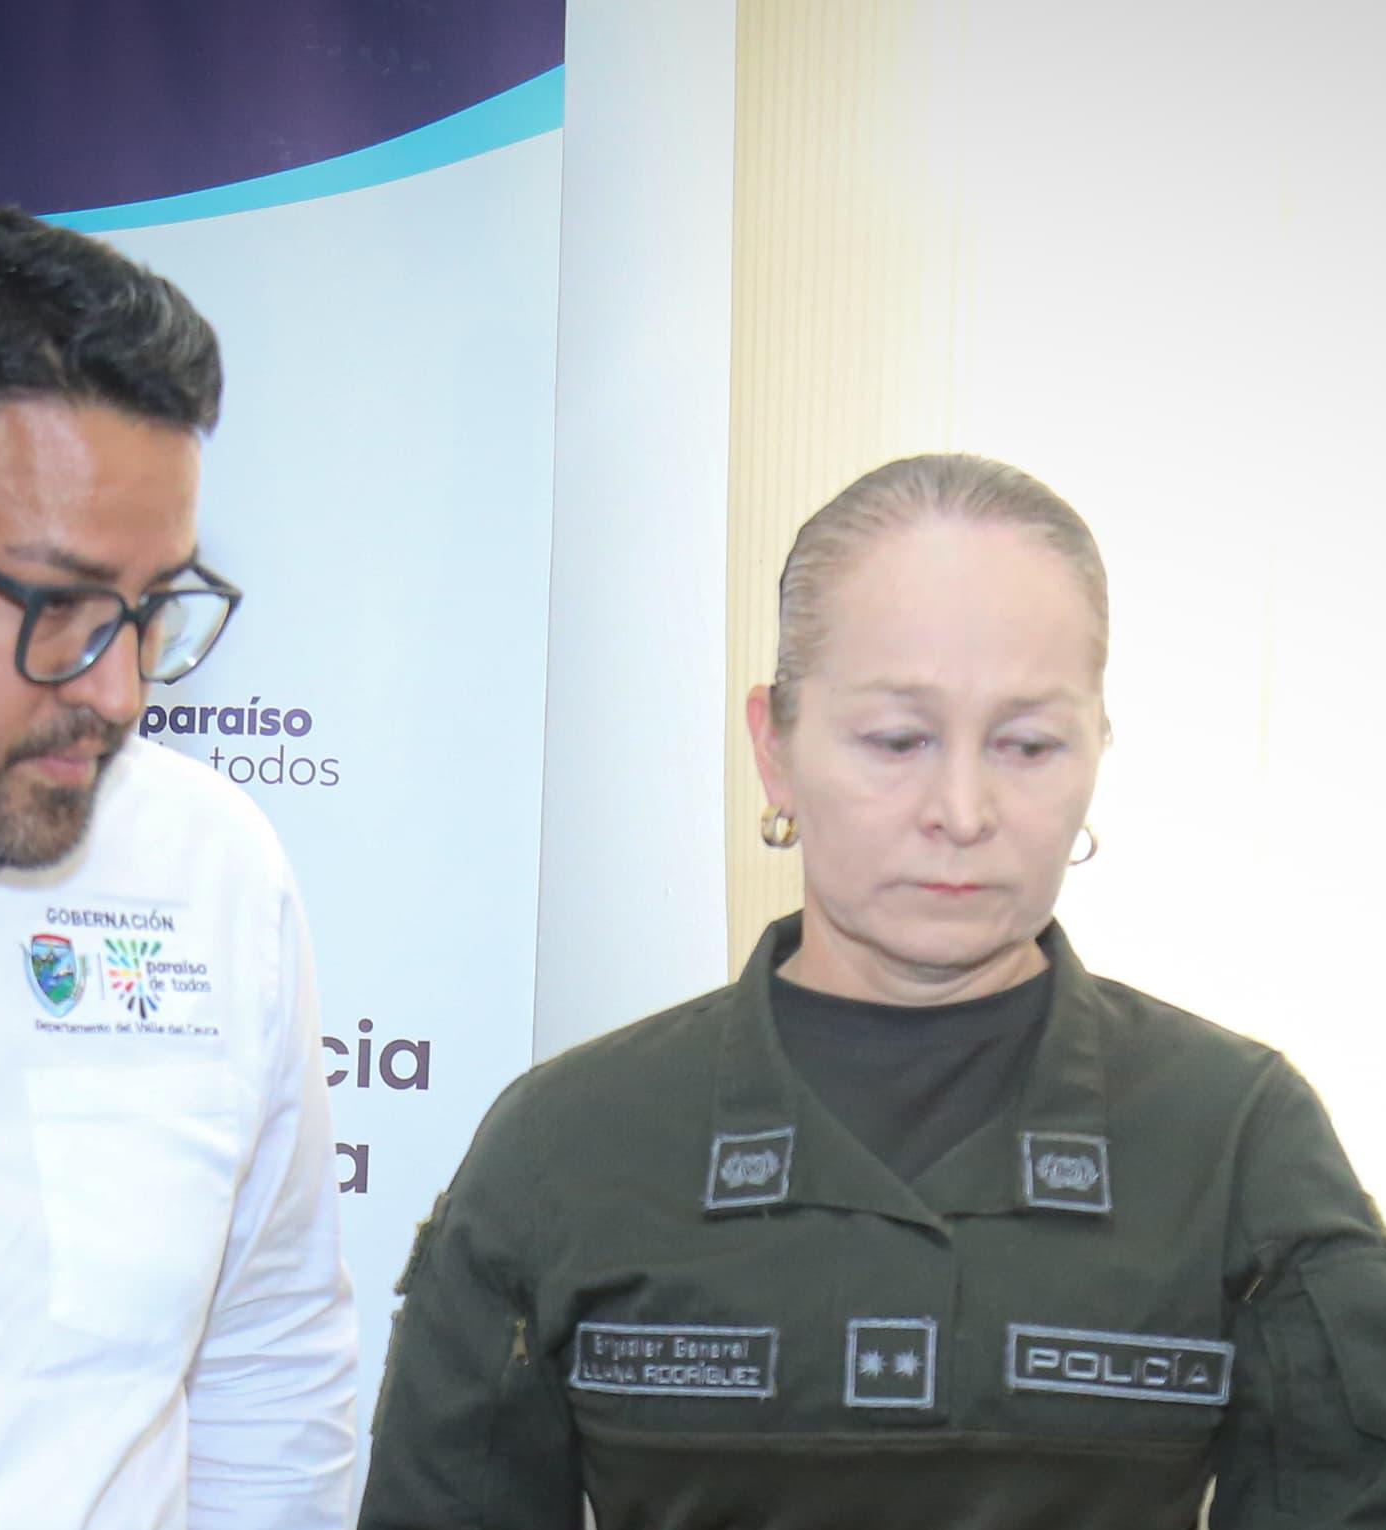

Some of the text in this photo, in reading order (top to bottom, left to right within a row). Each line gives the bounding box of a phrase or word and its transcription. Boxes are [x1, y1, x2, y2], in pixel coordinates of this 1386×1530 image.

[139, 696, 313, 739] paraíso
[210, 744, 340, 787] todos
[46, 907, 175, 932] GOBERNACIÓN
[149, 977, 213, 993] de todos
[35, 1019, 112, 1034] Departamento
[673, 1336, 750, 1359] General
[642, 1361, 762, 1387] RODRÍGUEZ
[1027, 1347, 1212, 1388] POLICÍA
